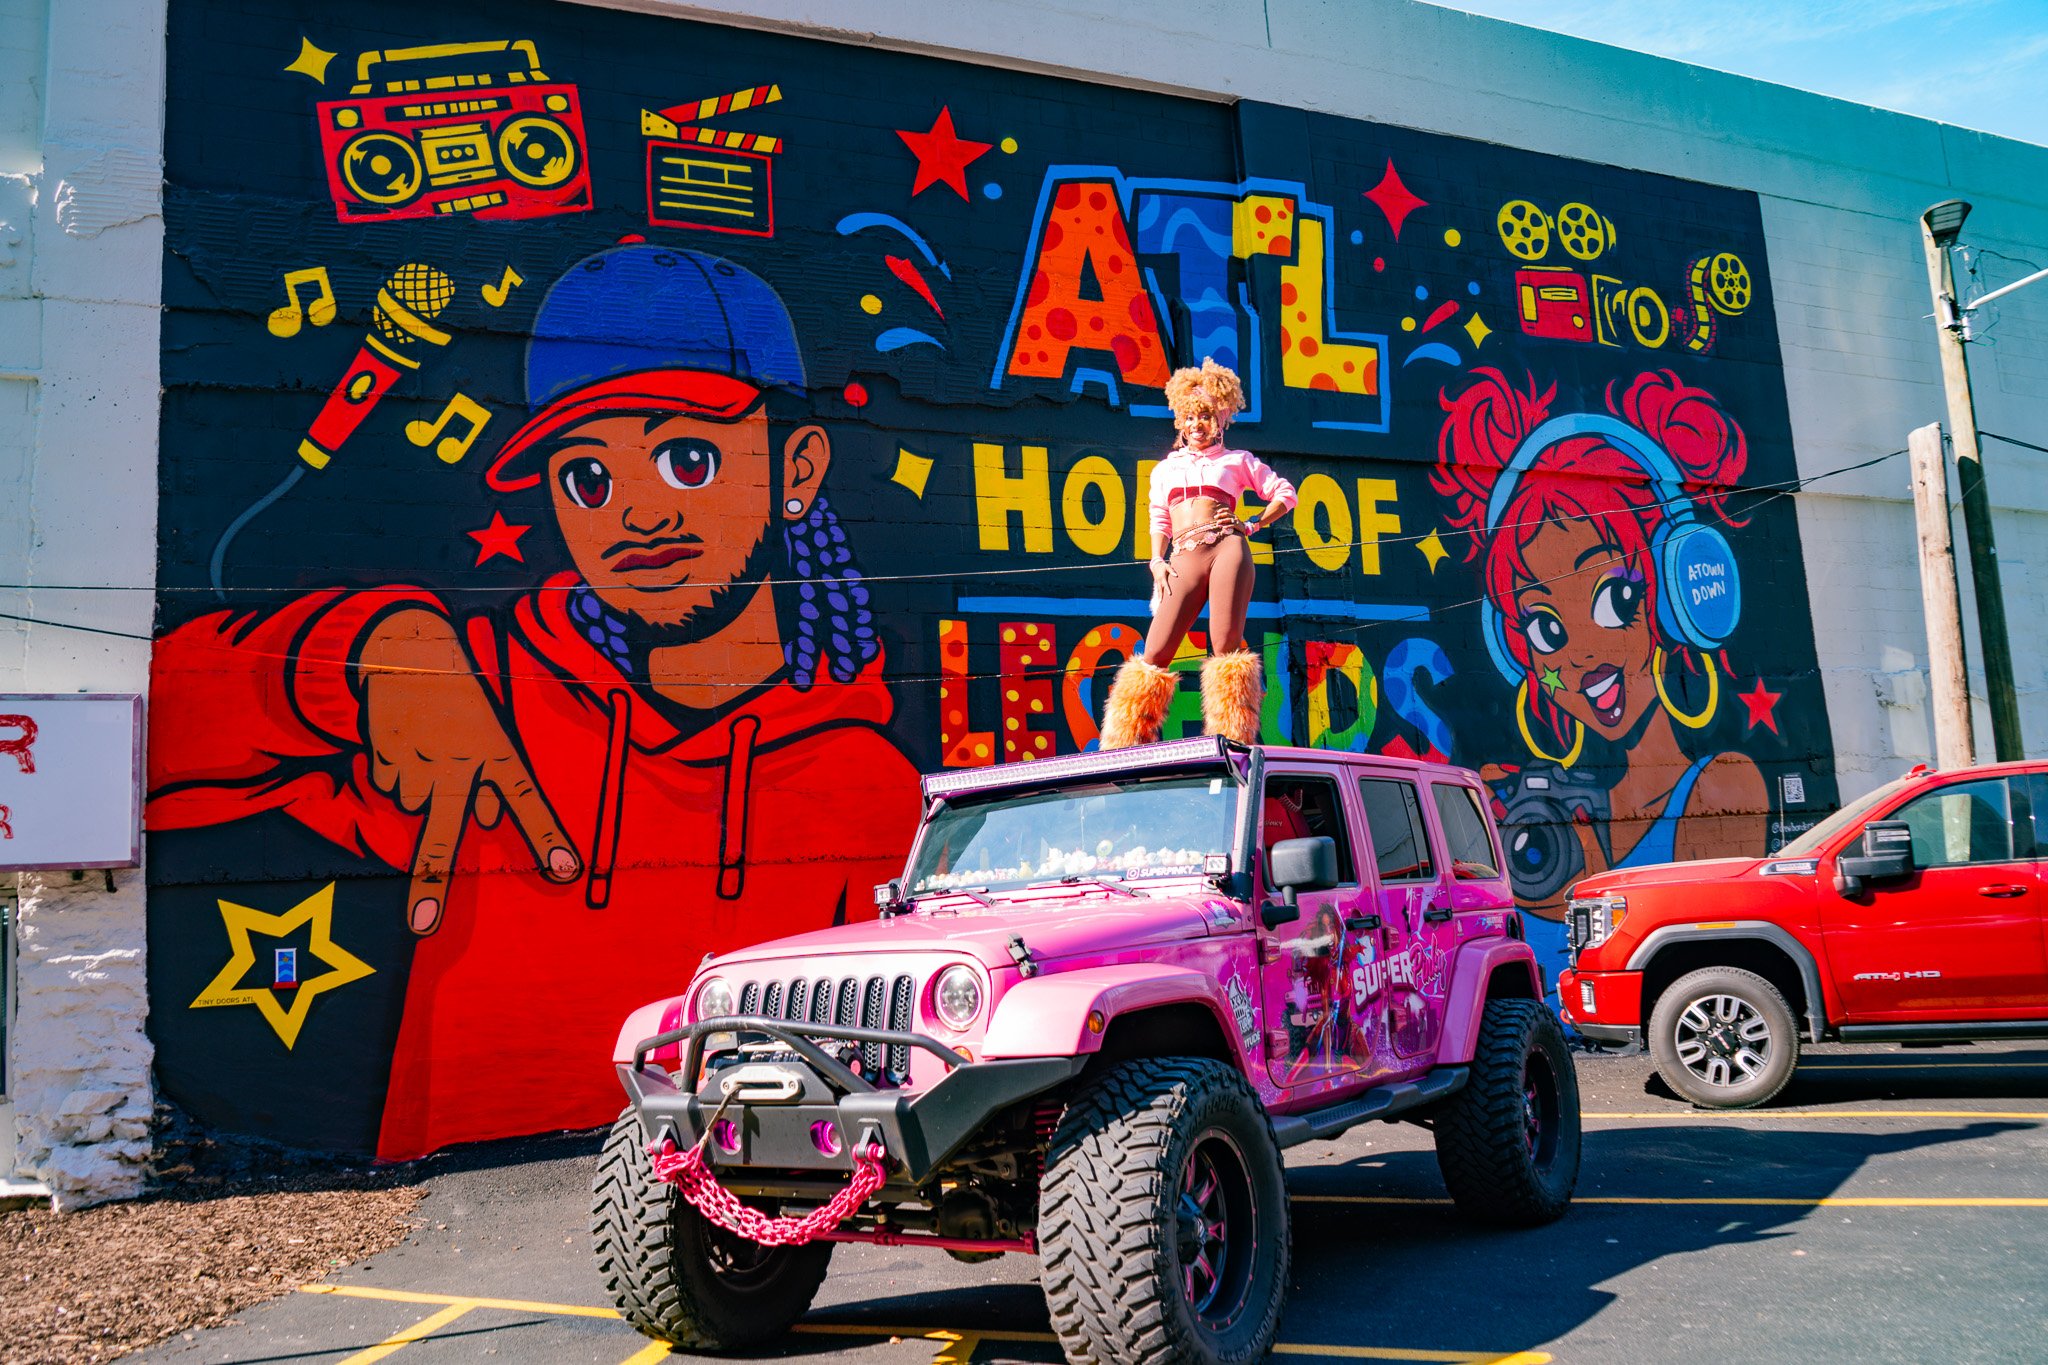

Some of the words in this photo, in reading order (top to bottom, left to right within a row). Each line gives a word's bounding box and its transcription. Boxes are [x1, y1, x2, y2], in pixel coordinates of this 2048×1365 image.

[998, 172, 1386, 420] ATL
[1292, 473, 1402, 577] OF
[1692, 580, 1726, 606] DOWN
[1352, 950, 1414, 1007] SUPER
[1903, 970, 1941, 979] HD
[216, 997, 240, 1005] DOORS
